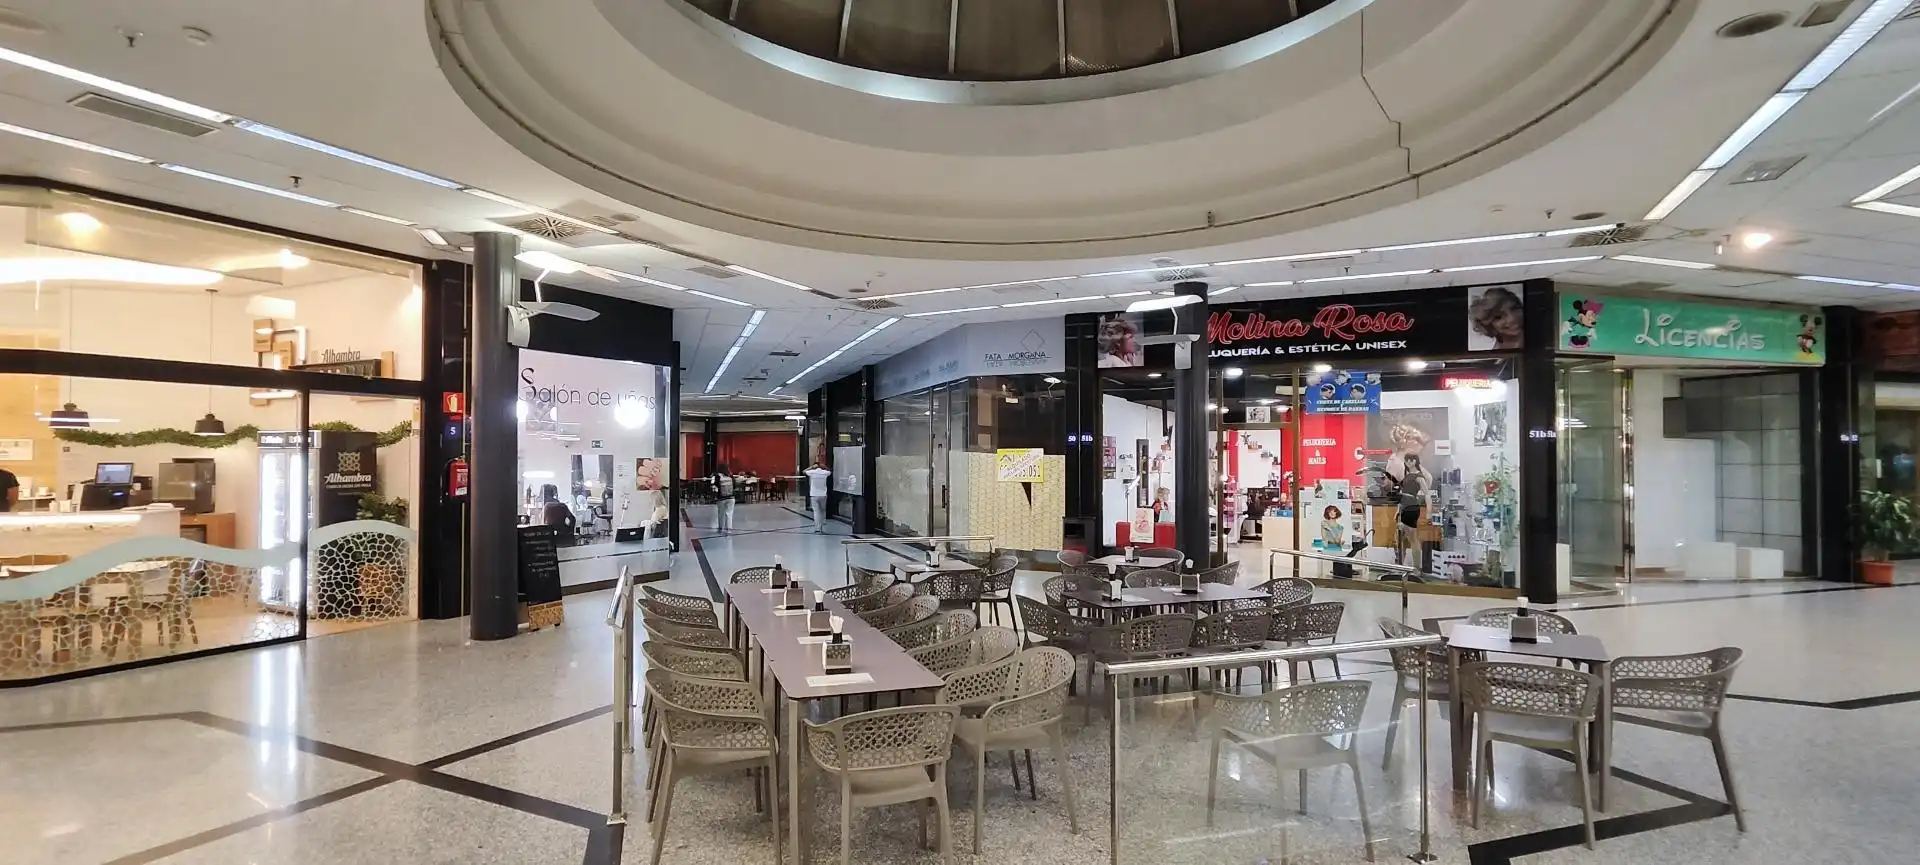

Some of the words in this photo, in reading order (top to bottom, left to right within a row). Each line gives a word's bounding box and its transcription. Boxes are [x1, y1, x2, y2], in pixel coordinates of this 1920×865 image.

[1208, 311, 1310, 345] Molina
[1313, 304, 1415, 340] Rosa
[1275, 346, 1285, 355] &
[1288, 343, 1351, 354] ESTÉTICA
[1355, 340, 1407, 350] UNISEX
[984, 353, 1002, 361] FATA
[1008, 351, 1047, 360] MORGANA
[519, 367, 581, 404] Salón
[587, 388, 612, 406] de
[450, 426, 456, 436] 5
[1529, 430, 1546, 438] 51b
[324, 472, 372, 485] Alhambra
